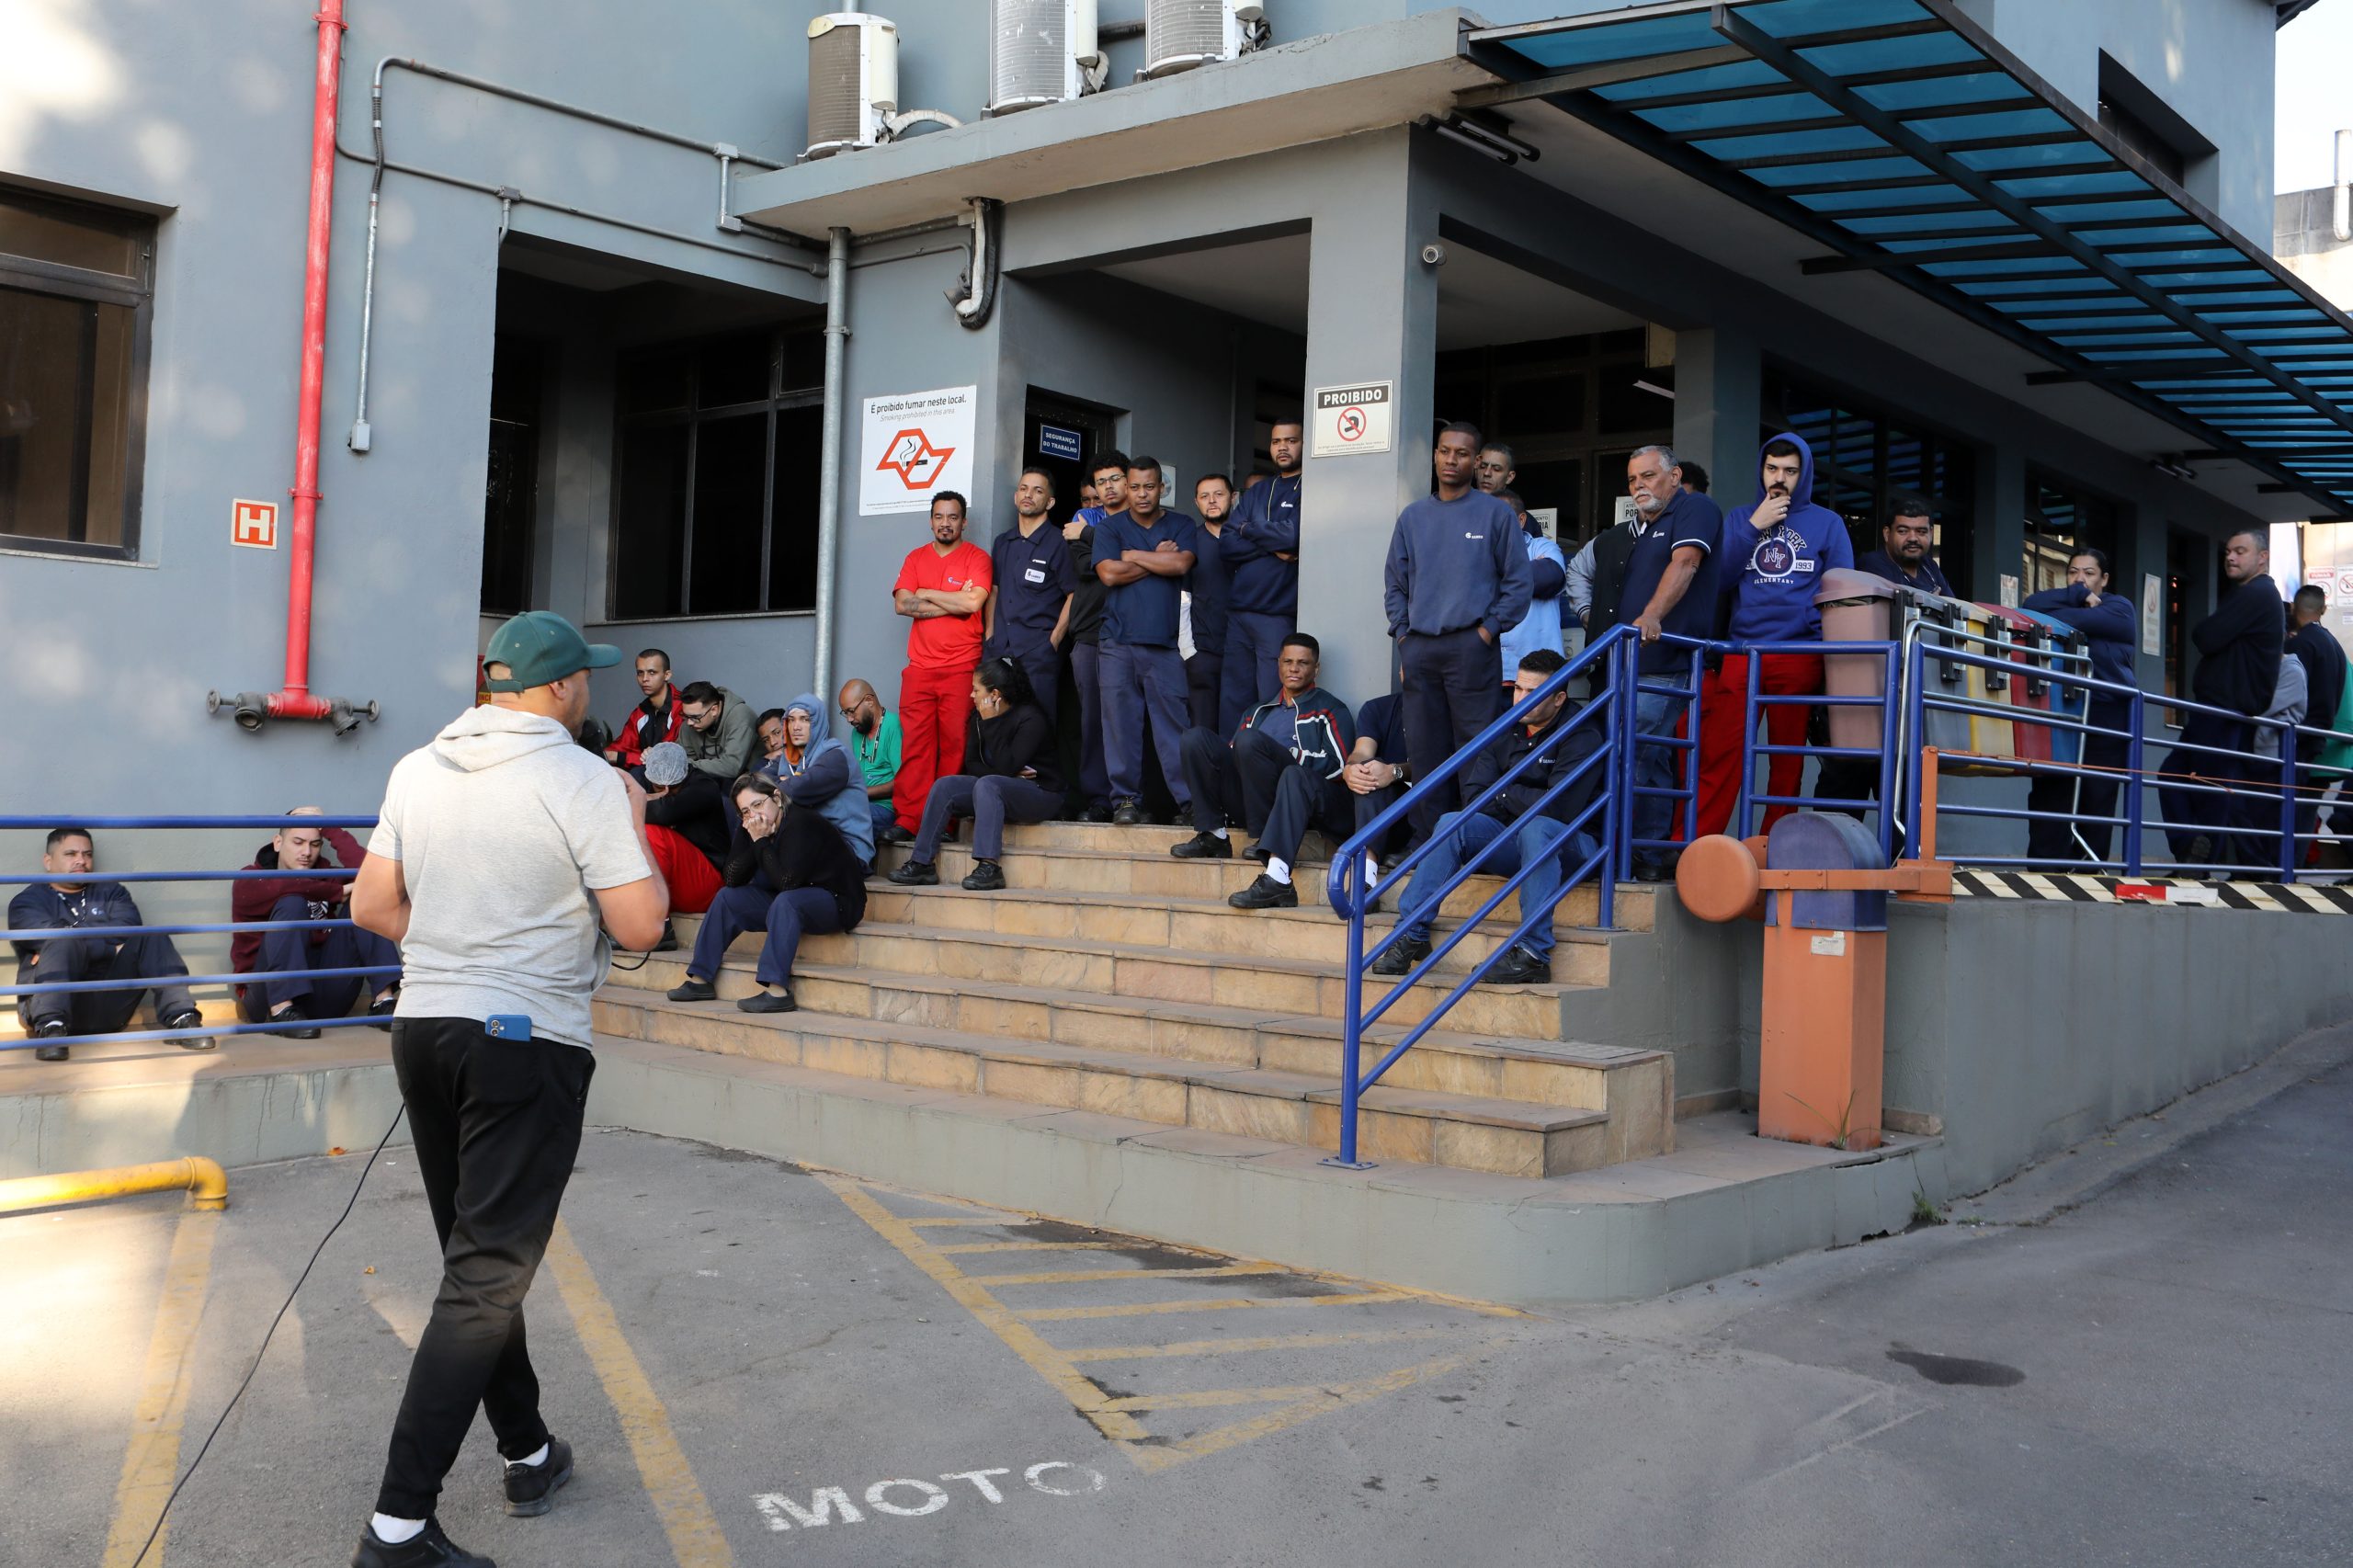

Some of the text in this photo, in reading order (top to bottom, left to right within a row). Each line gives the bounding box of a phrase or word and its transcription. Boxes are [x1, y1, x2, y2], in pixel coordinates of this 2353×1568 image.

[870, 393, 967, 415] É proibido fumar neste local.
[1324, 389, 1382, 405] PROIBIDO
[880, 413, 902, 422] Smoking
[902, 411, 927, 421] prohibited
[1045, 432, 1075, 444] SEGURANÇA
[1051, 442, 1077, 453] TRABALHO
[239, 506, 270, 542] H
[1764, 548, 1785, 569] NY
[1795, 562, 1813, 570] 1993
[749, 1460, 1108, 1532] MOTO
